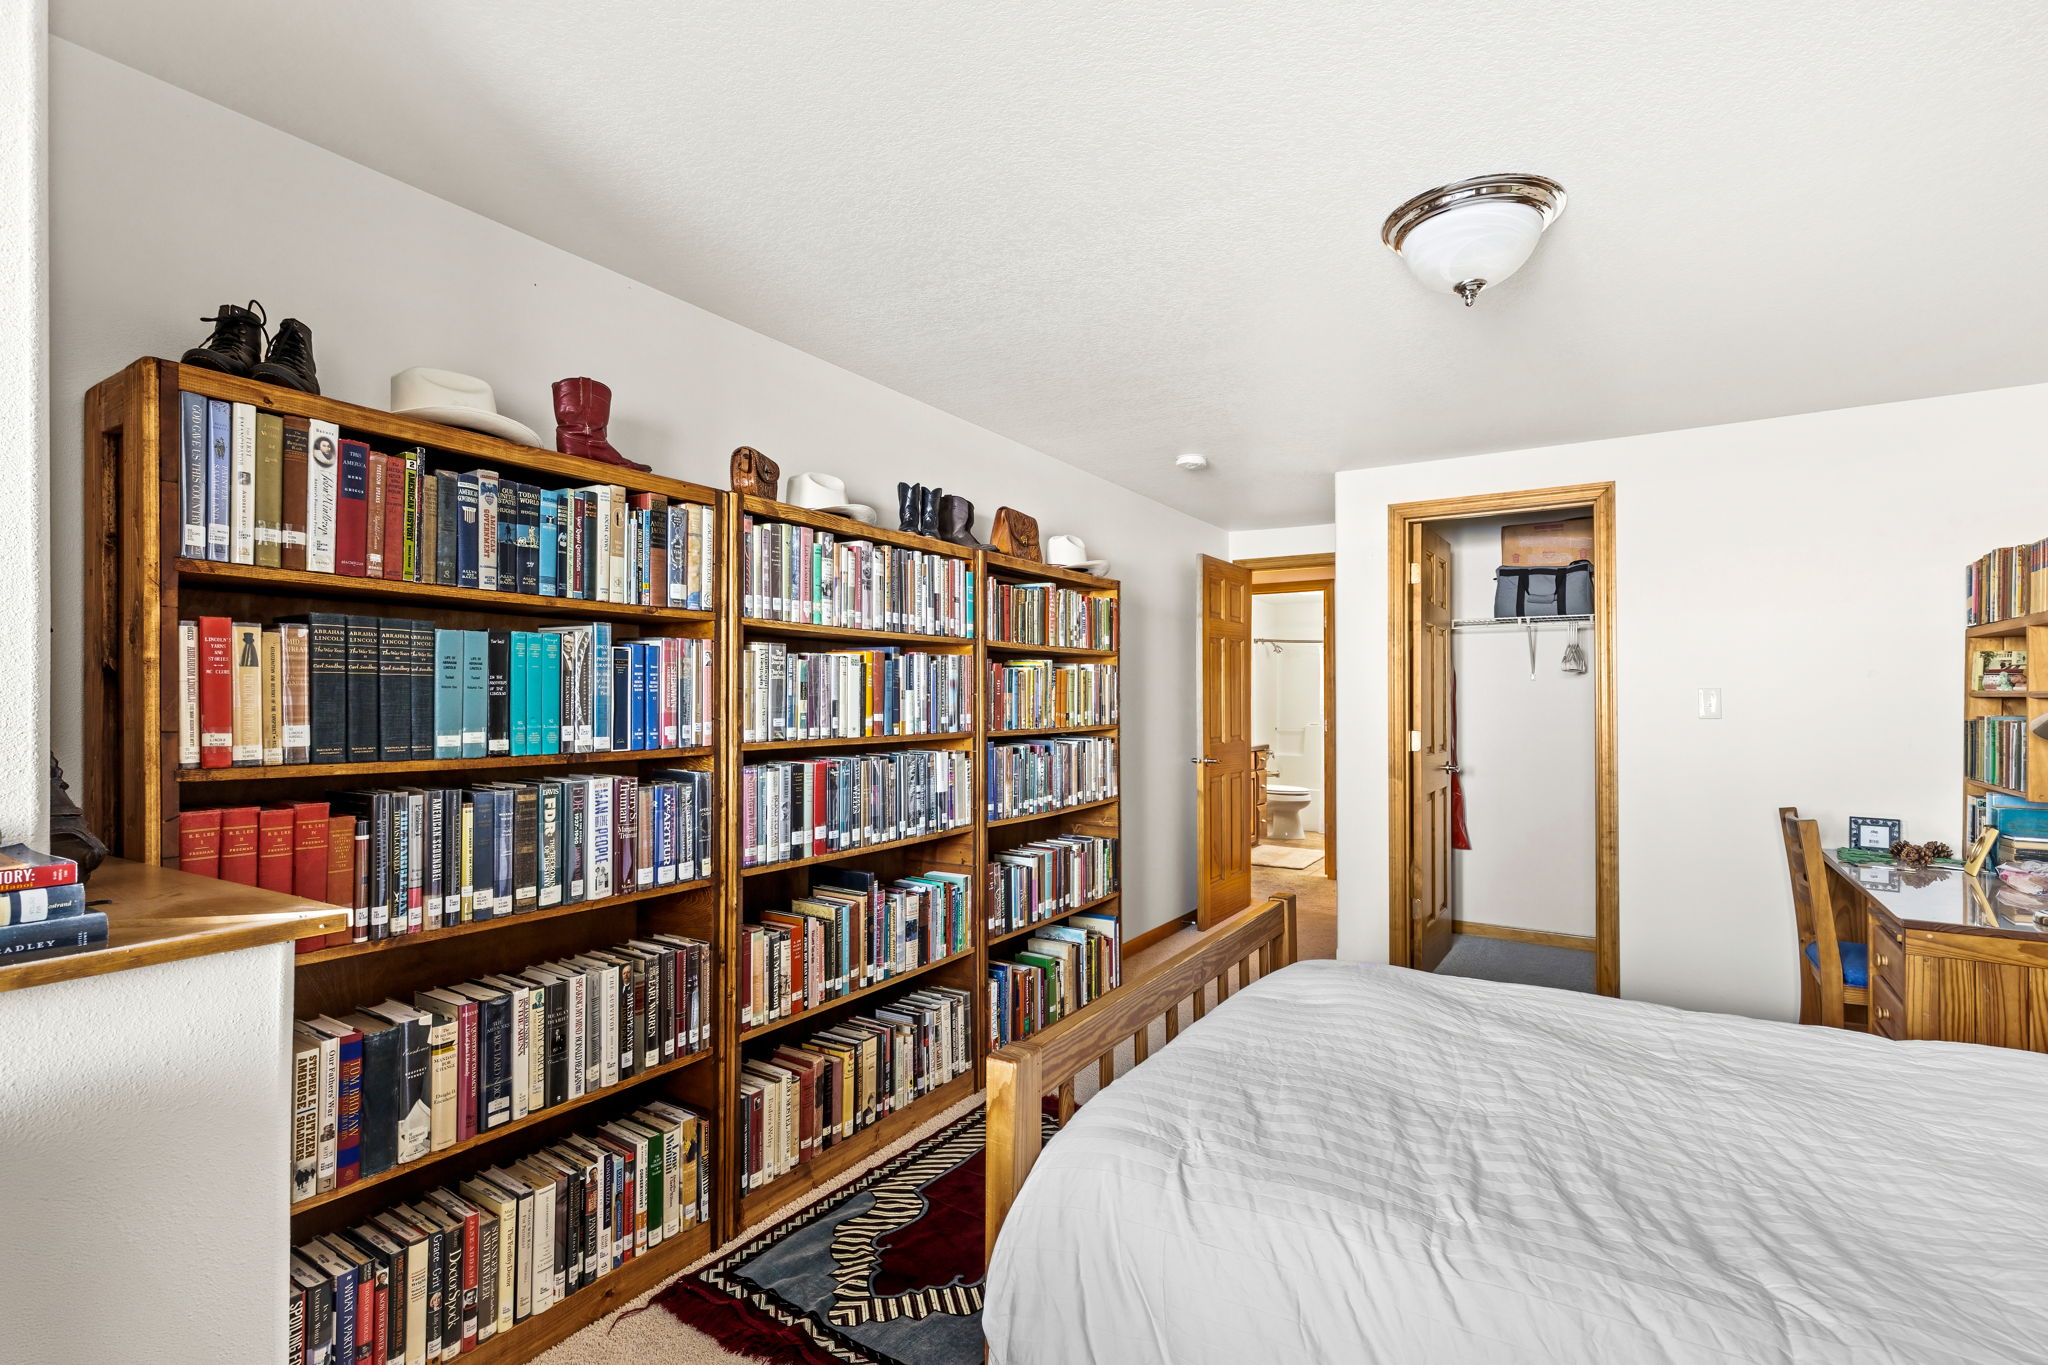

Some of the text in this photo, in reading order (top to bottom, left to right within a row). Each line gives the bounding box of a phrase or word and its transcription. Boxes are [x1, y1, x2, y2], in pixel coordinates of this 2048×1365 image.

[192, 404, 202, 525] GOD GAVE US THIS COUNTRY
[407, 472, 416, 510] AMERICAN
[406, 511, 414, 542] HISTORY
[187, 646, 195, 676] ABRAHAM
[544, 797, 556, 837] FDR:
[572, 786, 584, 811] FDR
[595, 789, 608, 814] MAN
[619, 781, 630, 823] Truman
[432, 798, 442, 882] AMERICAN SCOUNDREL
[595, 828, 608, 865] PEOPLE
[575, 978, 584, 1008] SPEAKING
[648, 1002, 656, 1038] WARREN
[297, 1058, 307, 1110] AMBROSE
[308, 1055, 317, 1108] STEPHEN E.
[348, 1058, 361, 1136] TOM BROKAW
[327, 1100, 335, 1117] War
[296, 1116, 305, 1161] SOLDIERS
[305, 1112, 316, 1158] CITIZEN
[665, 1134, 674, 1174] Woman
[432, 1234, 442, 1288] Grace Grit
[483, 1231, 491, 1250] AND
[444, 1249, 462, 1330] Doctor Spock
[289, 1300, 304, 1351] SPOILING
[343, 1282, 354, 1359] WHAT A PARTY!
